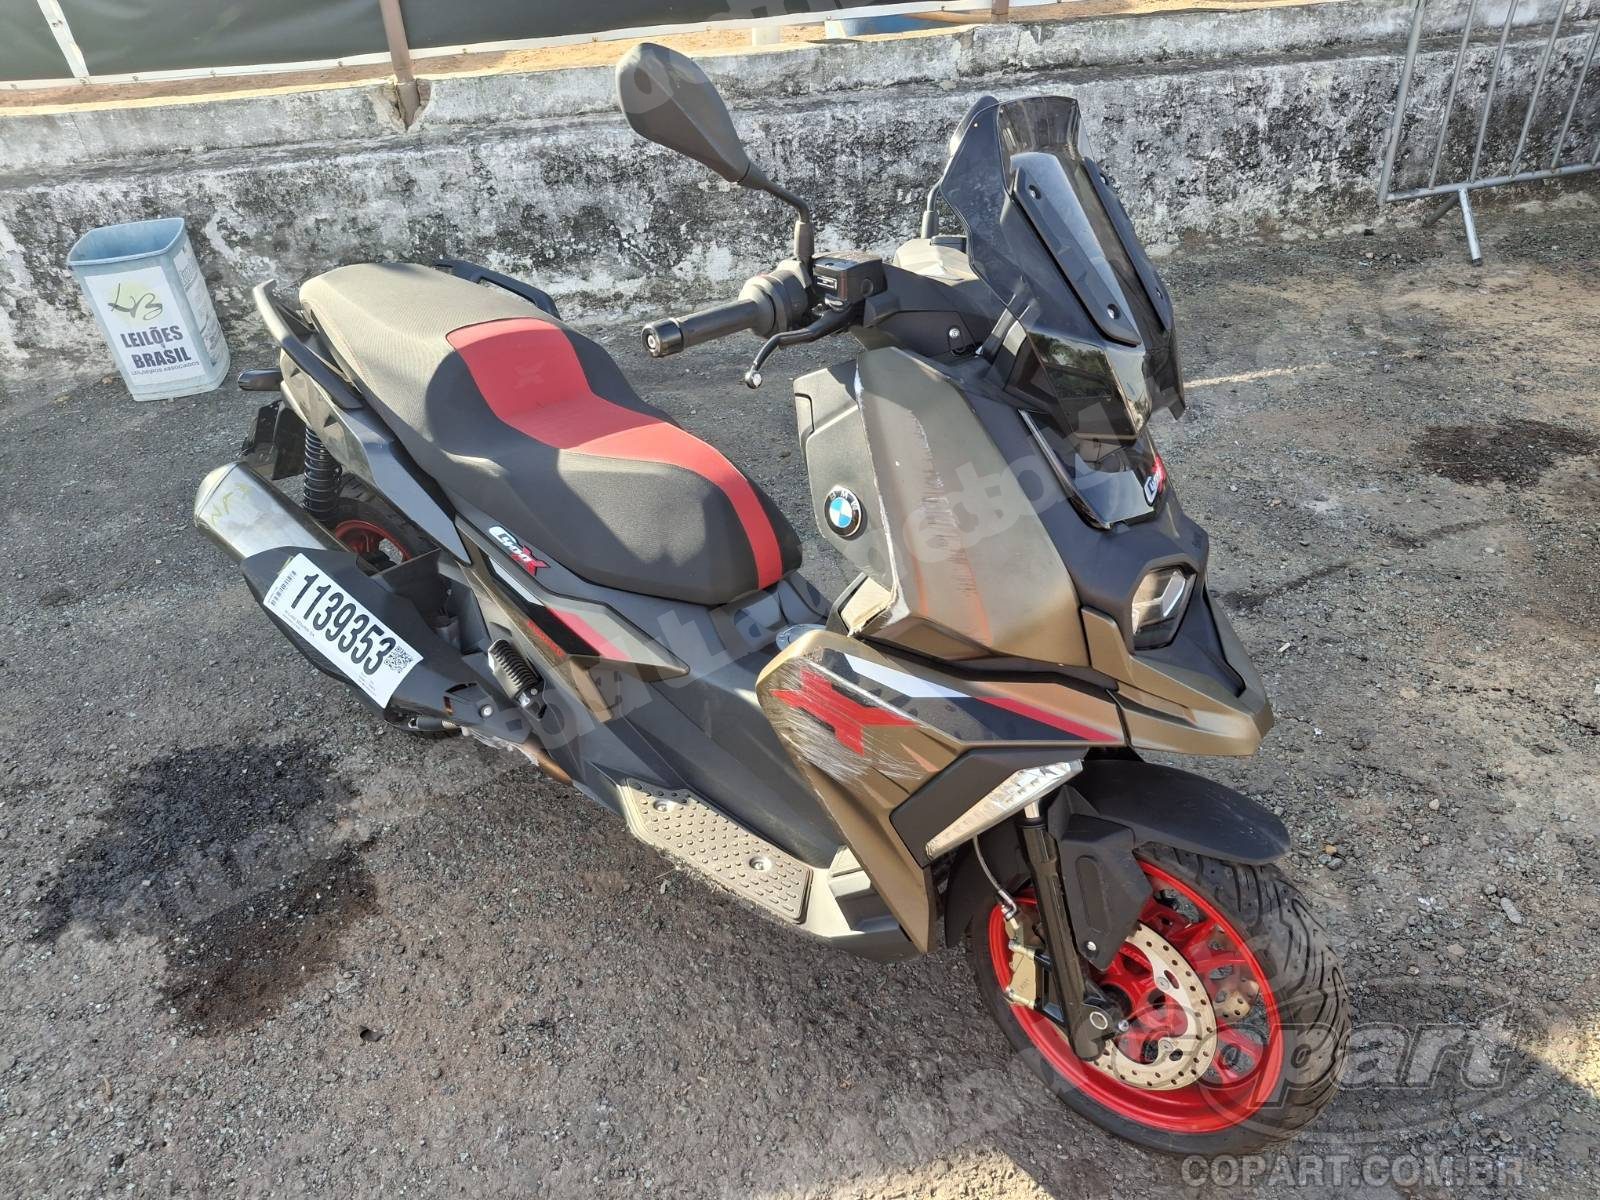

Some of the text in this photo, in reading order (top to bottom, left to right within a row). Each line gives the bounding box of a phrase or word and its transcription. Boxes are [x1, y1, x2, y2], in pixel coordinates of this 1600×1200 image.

[120, 325, 183, 349] LEILÕES
[131, 347, 192, 368] BRASIL
[291, 573, 396, 675] 1139353
